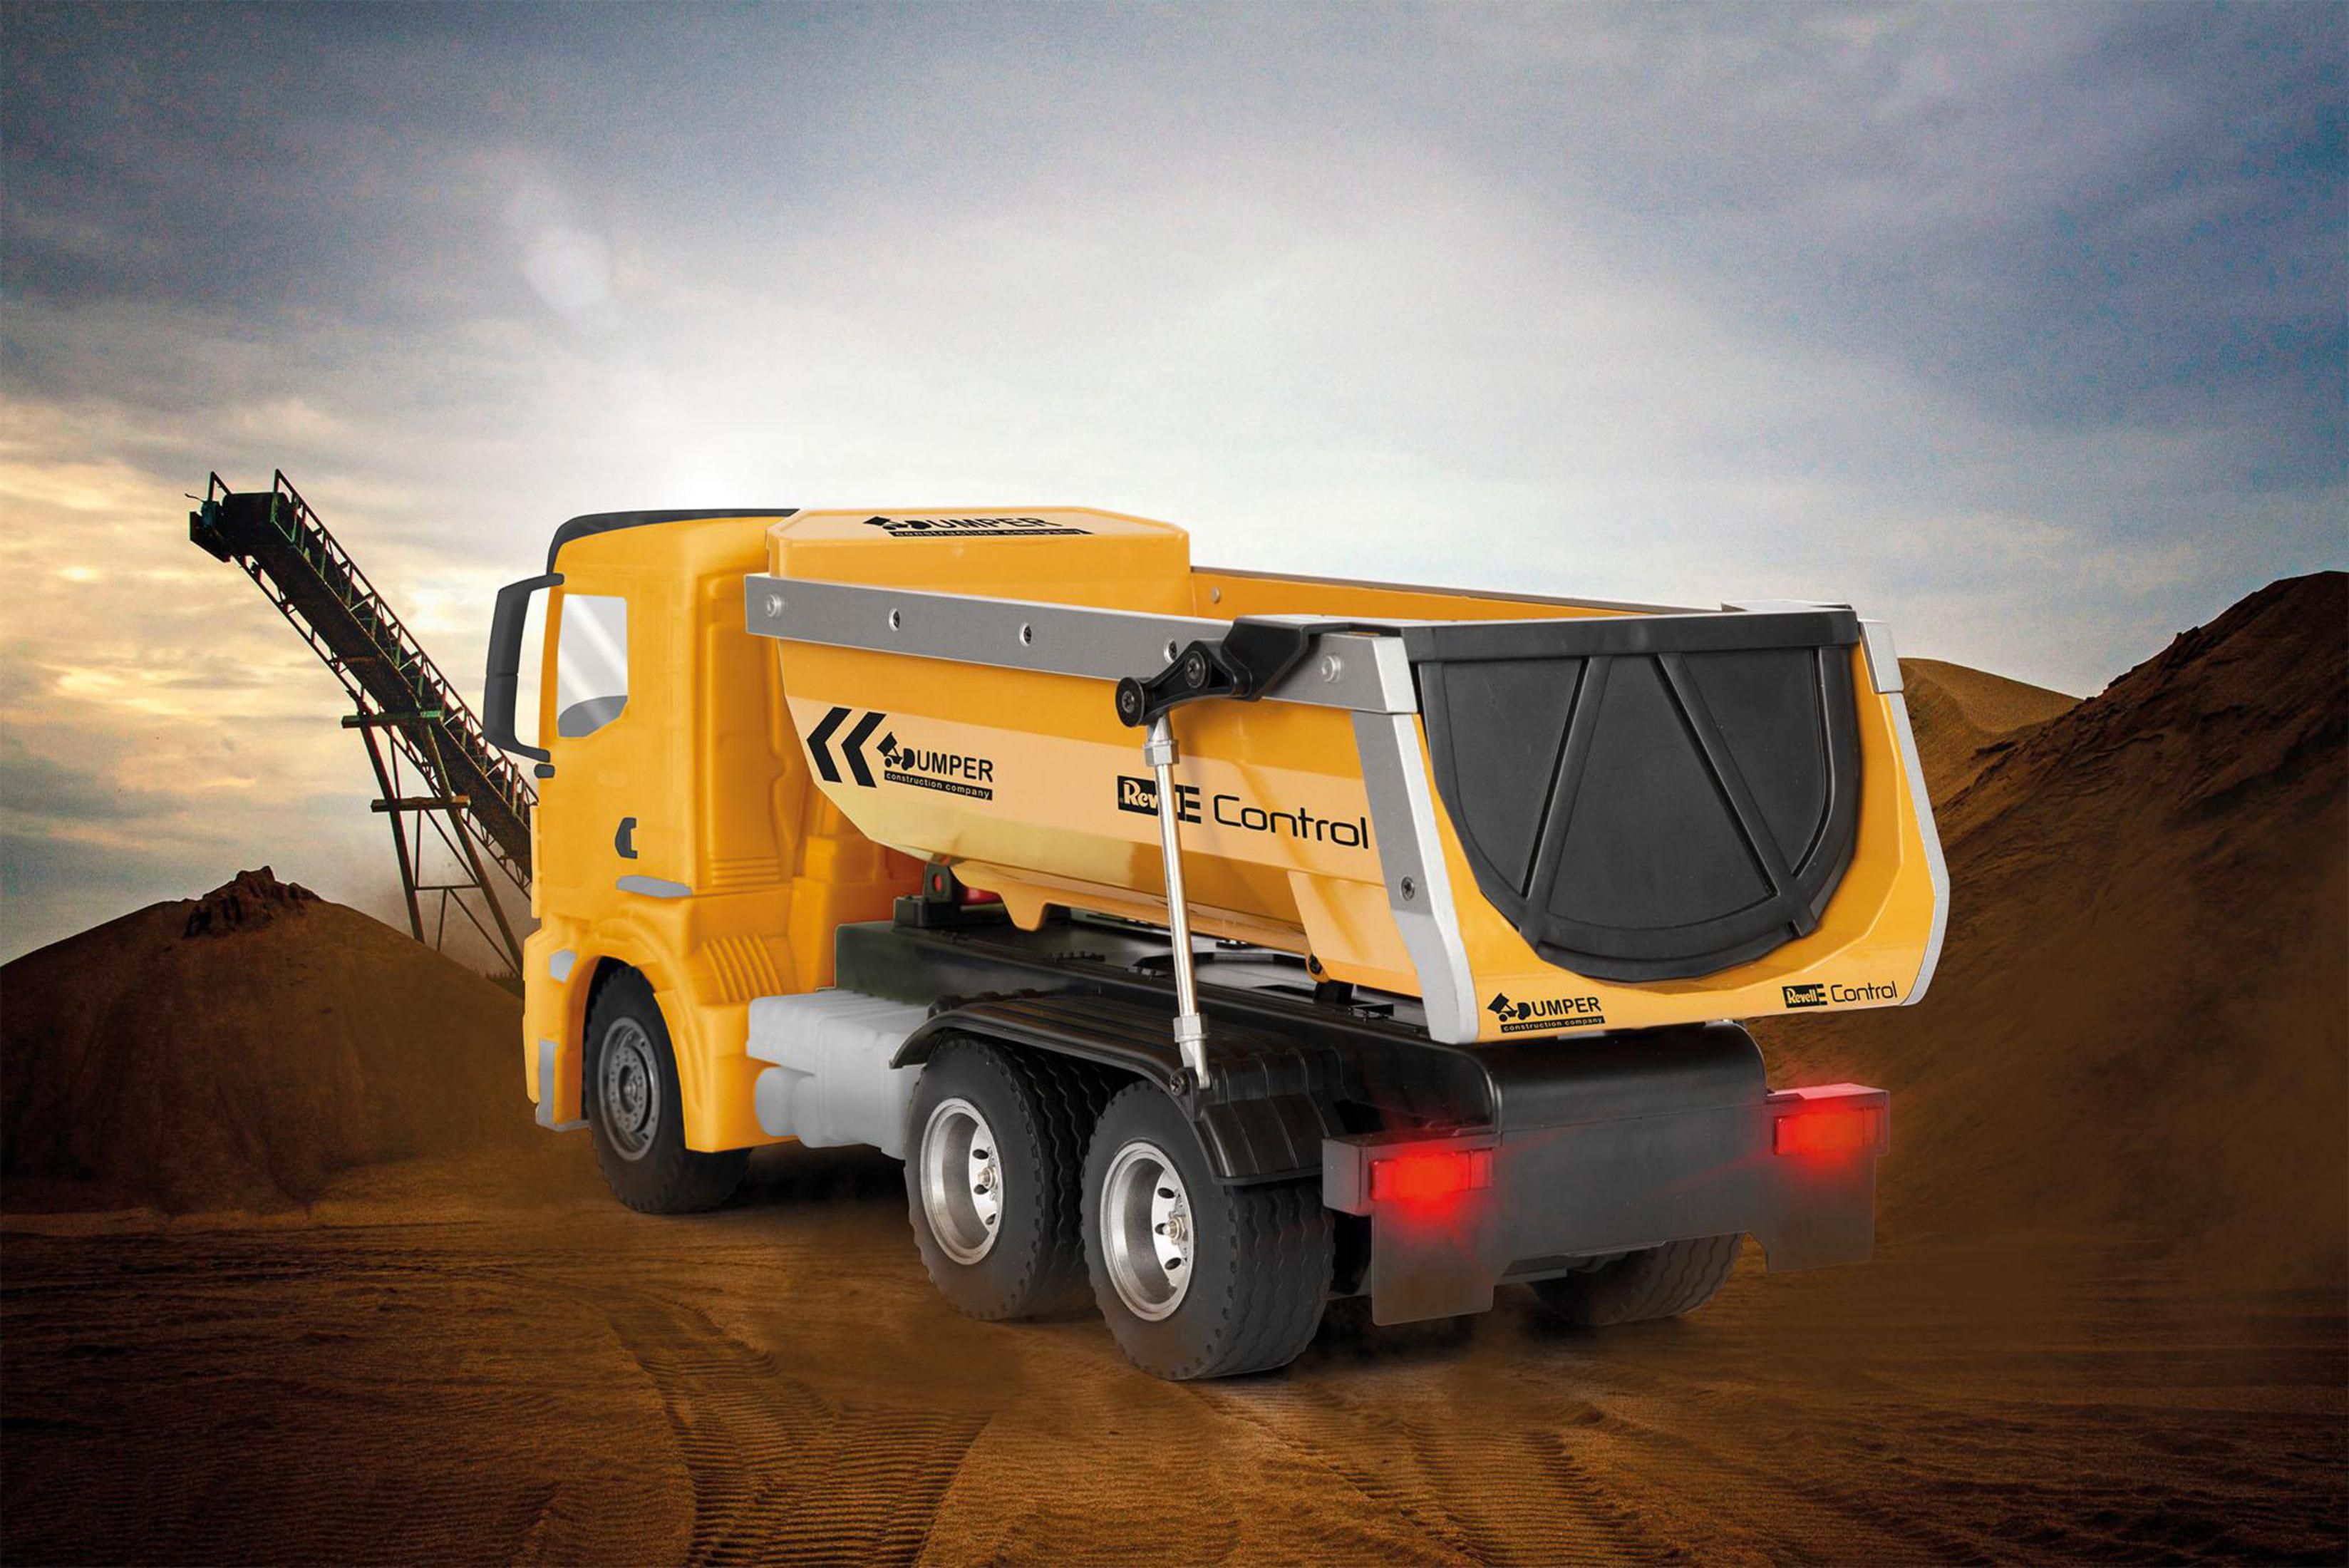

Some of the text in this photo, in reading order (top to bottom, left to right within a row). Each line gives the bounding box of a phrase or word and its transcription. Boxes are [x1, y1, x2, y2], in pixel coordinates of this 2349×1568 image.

[901, 748, 993, 783] DUMPER
[886, 772, 991, 799] construction company
[1213, 794, 1369, 850] Control
[1830, 980, 1898, 1003] Control
[1517, 996, 1602, 1021] DUMPER
[1502, 1016, 1604, 1032] construction company
